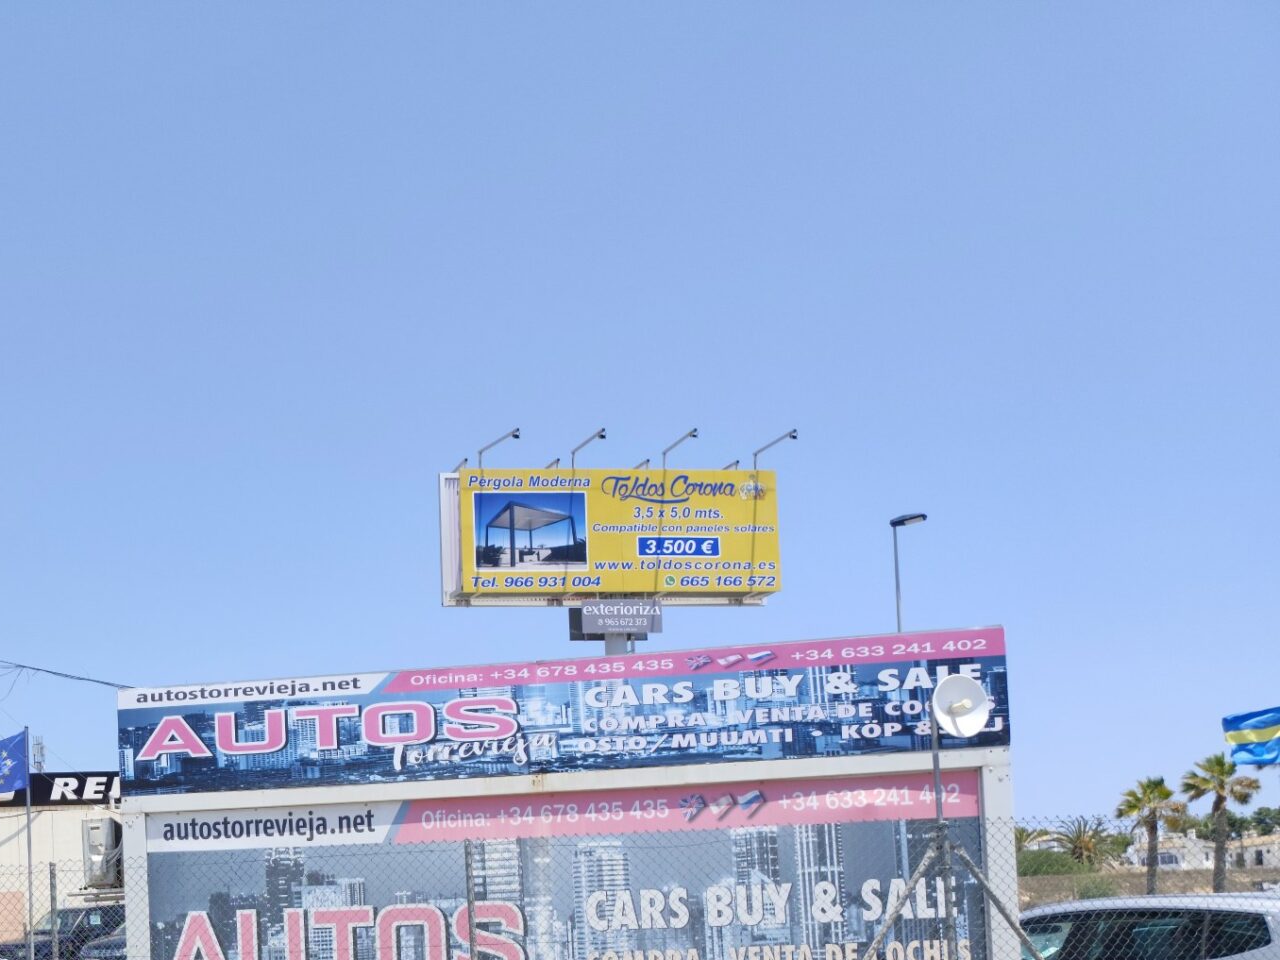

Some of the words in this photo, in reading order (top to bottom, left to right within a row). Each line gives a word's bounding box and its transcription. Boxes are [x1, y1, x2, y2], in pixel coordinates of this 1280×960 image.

[468, 476, 524, 490] Pergola
[528, 476, 591, 487] Moderna
[601, 475, 666, 501] Toldos
[670, 475, 736, 497] Corona
[633, 506, 654, 519] 3,5
[670, 506, 691, 519] 5,0
[695, 507, 724, 519] mts.
[592, 523, 658, 533] Compatible
[661, 524, 683, 532] con
[686, 524, 730, 534] paneles
[734, 524, 775, 533] solares
[645, 539, 696, 554] 3.500
[701, 540, 714, 554] €
[594, 559, 776, 570] www.toldoscorona.es
[471, 576, 499, 588] Tel.
[504, 577, 534, 588] 966
[538, 577, 567, 588] 931
[572, 576, 601, 587] 004
[680, 576, 710, 587] 665
[715, 576, 743, 587] 166
[746, 576, 776, 587] 572
[605, 617, 619, 626] 965
[791, 649, 834, 662] +34
[841, 646, 885, 658] 633
[892, 642, 936, 655] 241
[942, 639, 987, 652] 402
[410, 673, 483, 686] Oficina:
[490, 667, 530, 681] +34
[536, 665, 578, 678] 678
[584, 662, 626, 675] 435
[632, 659, 674, 672] 435
[136, 677, 361, 703] autostorrevieja.net
[584, 681, 695, 708] CARS
[713, 674, 804, 701] BUY
[825, 671, 858, 695] &
[136, 696, 520, 761] AUTOS
[584, 713, 707, 732] COMPRA
[735, 704, 828, 725] VENTA
[837, 703, 873, 719] DE
[577, 728, 793, 753] OSTO/MUUMTI
[841, 719, 902, 740] KÖP
[389, 733, 557, 771] Torrevieja
[778, 791, 819, 811] +34
[825, 789, 867, 809] 633
[873, 786, 914, 806] 241
[163, 809, 375, 842] autostorrevieja.net
[422, 810, 490, 830] Oficina:
[497, 806, 534, 826] +34
[540, 804, 579, 824] 678
[585, 802, 624, 821] 435
[630, 799, 669, 819] 435
[585, 887, 690, 932] CARS
[705, 882, 793, 927] BUY
[812, 881, 844, 923] &
